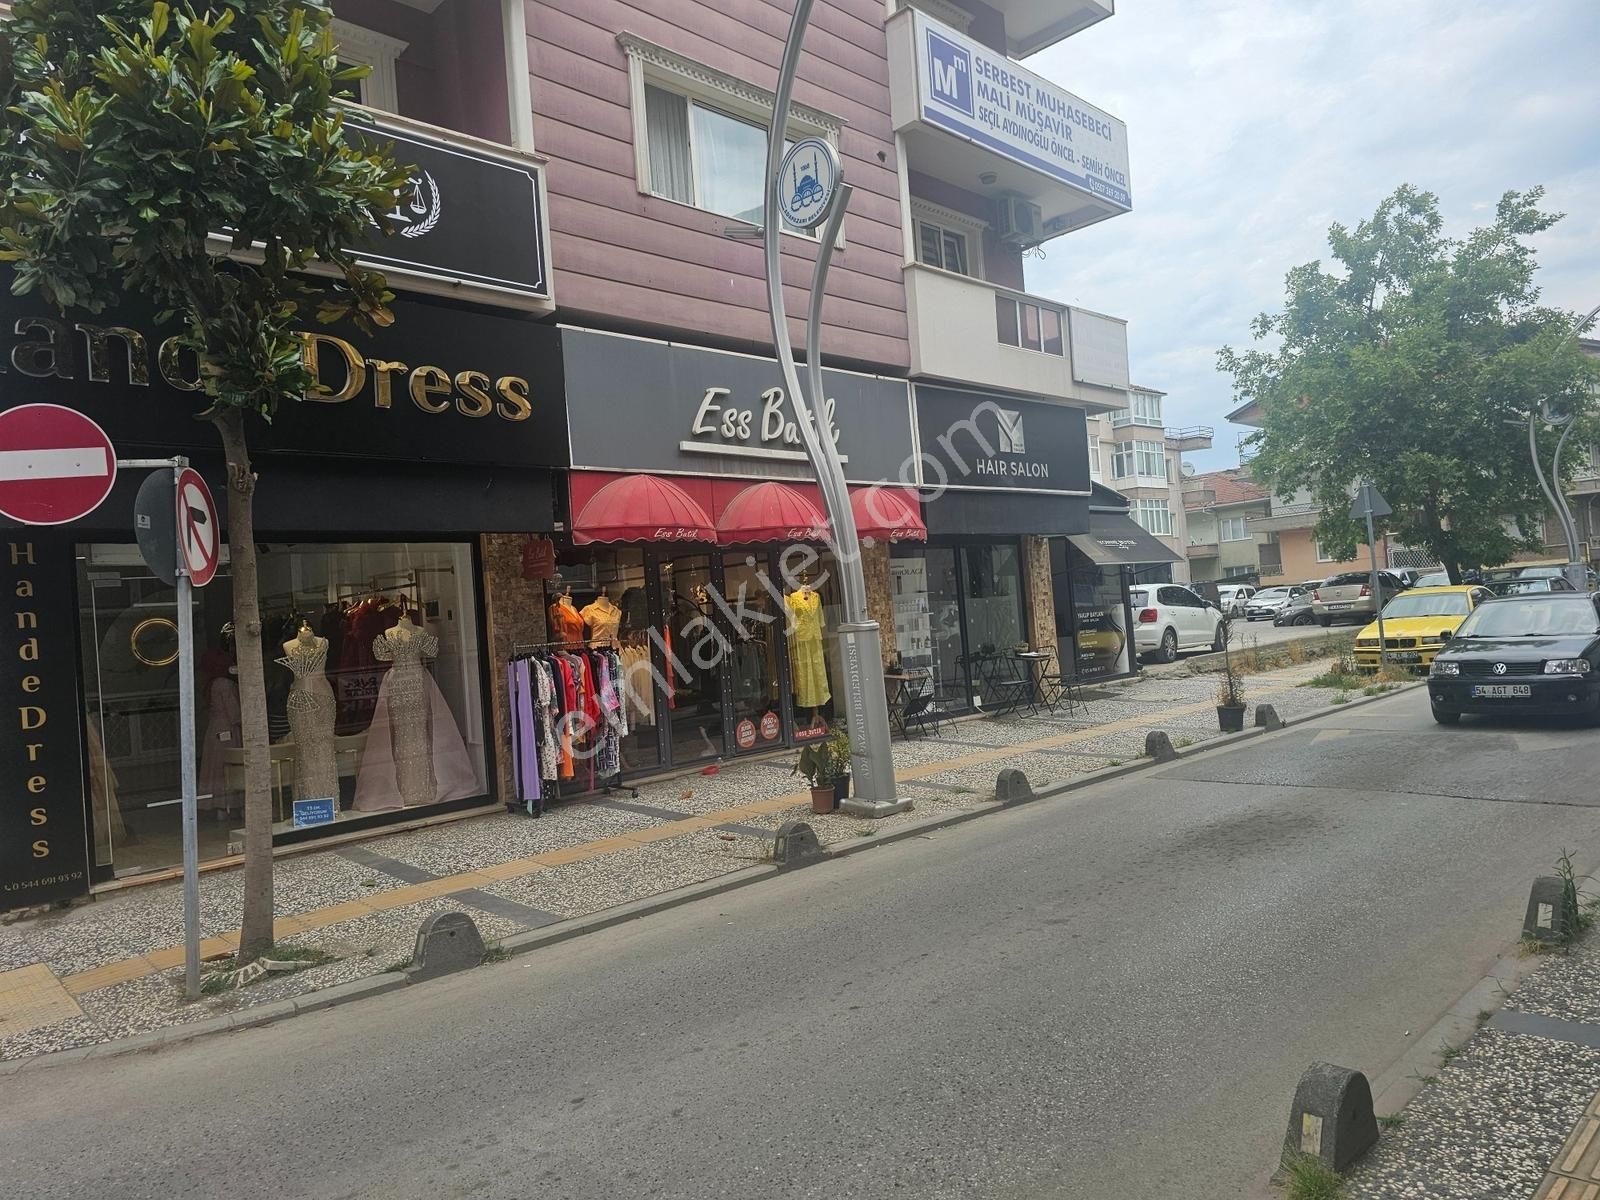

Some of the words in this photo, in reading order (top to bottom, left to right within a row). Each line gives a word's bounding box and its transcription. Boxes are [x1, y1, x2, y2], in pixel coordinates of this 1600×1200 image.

[975, 56, 1032, 100] SERBEST
[1036, 88, 1112, 141] MUHASEBECİ
[977, 79, 1011, 112] MALİ
[1015, 100, 1073, 142] MÜŞAVİR
[978, 105, 1001, 130] SEÇİL
[1002, 117, 1049, 151] AYDINOĞLU
[1050, 138, 1075, 164] ÖNCEL
[1081, 155, 1103, 176] SEMİH
[290, 331, 533, 421] Dress
[691, 387, 752, 440] Ess
[976, 458, 1008, 476] HAIR
[1010, 461, 1049, 478] SALON
[654, 528, 673, 538] Ess
[1475, 687, 1489, 695] 54
[1492, 686, 1507, 695] AGT
